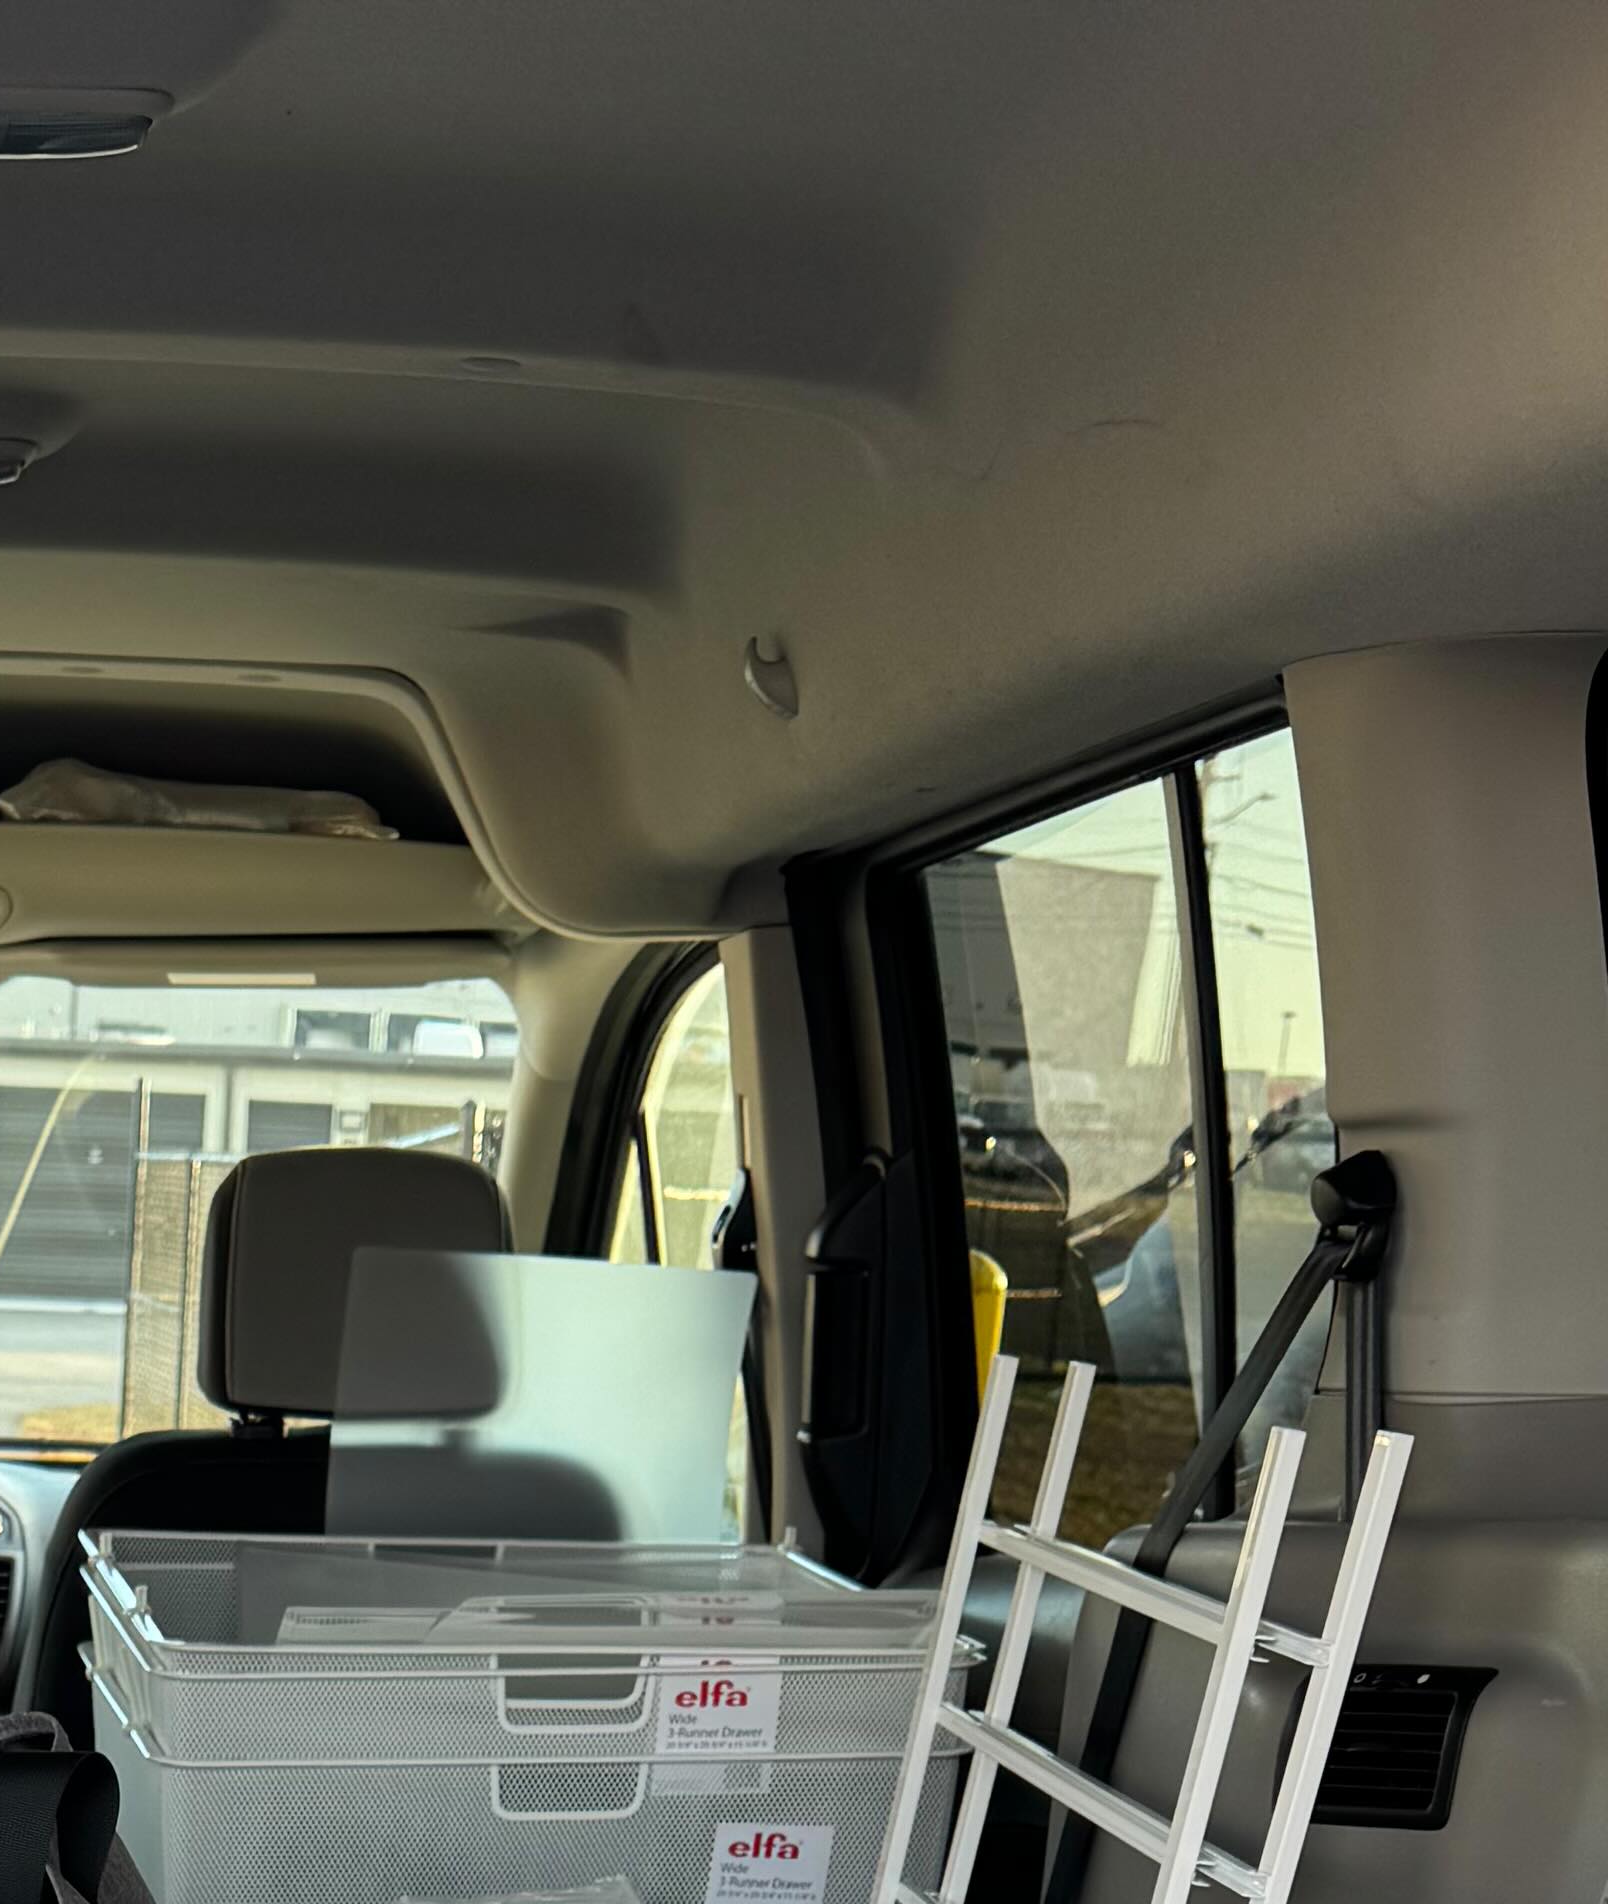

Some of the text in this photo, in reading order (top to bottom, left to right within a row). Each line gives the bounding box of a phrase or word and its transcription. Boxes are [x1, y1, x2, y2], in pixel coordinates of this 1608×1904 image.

[675, 1680, 748, 1708] elfa
[669, 1714, 697, 1725] Wide
[669, 1727, 762, 1738] 3-Runner Drawer
[728, 1832, 800, 1860] elfa
[720, 1863, 749, 1874] Wide
[772, 1878, 813, 1890] Drawer
